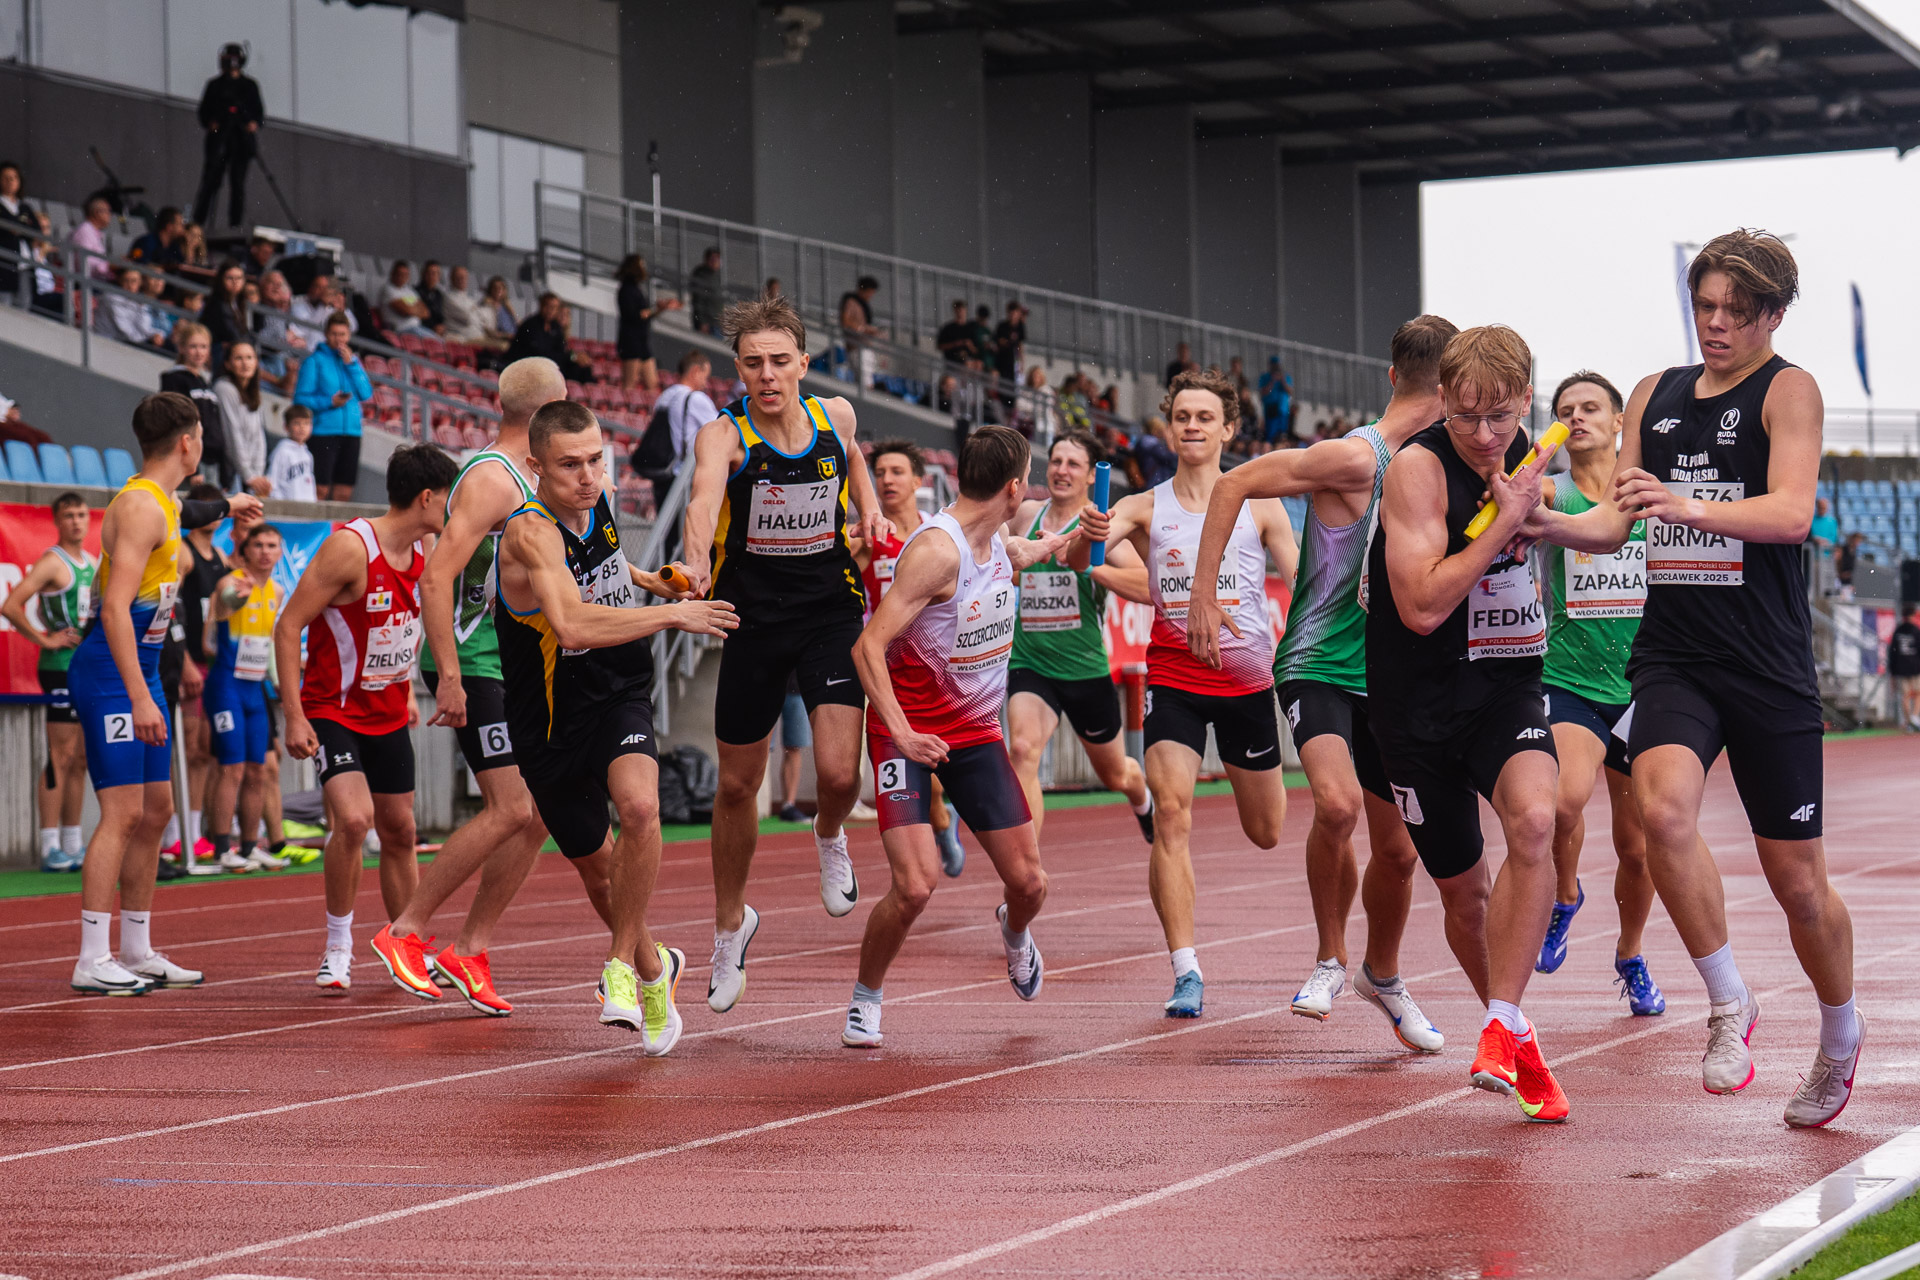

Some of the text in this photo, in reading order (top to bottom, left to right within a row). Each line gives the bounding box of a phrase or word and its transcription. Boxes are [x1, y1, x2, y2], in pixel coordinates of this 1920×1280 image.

[1652, 417, 1682, 434] 4F
[1716, 430, 1738, 438] RUDA
[810, 484, 829, 501] 72
[757, 509, 828, 530] HAŁUJA
[1652, 524, 1728, 548] SURMA
[755, 542, 827, 554] WŁOCŁAWEK 2025
[1613, 545, 1645, 561] 376
[602, 558, 619, 580] 85
[1718, 562, 1732, 570] U20
[1048, 575, 1071, 588] 130
[1573, 573, 1645, 592] ZAPAŁA
[1703, 573, 1730, 582] 2025
[995, 590, 1008, 609] 57
[1021, 595, 1077, 610] GRUSZKA
[966, 613, 982, 623] ORLEN
[1575, 608, 1625, 616] WŁOCŁAWEK
[956, 615, 1014, 649] SZCZERCZOWSKI
[1480, 642, 1546, 655] WŁOCŁAWEK
[112, 716, 128, 740] 2
[218, 713, 227, 729] 2
[487, 726, 506, 752] 6
[620, 733, 648, 746] 4F
[1515, 727, 1548, 740] 4F
[881, 761, 899, 790] 3
[1393, 788, 1409, 819] 7
[1789, 803, 1816, 822] 4F
